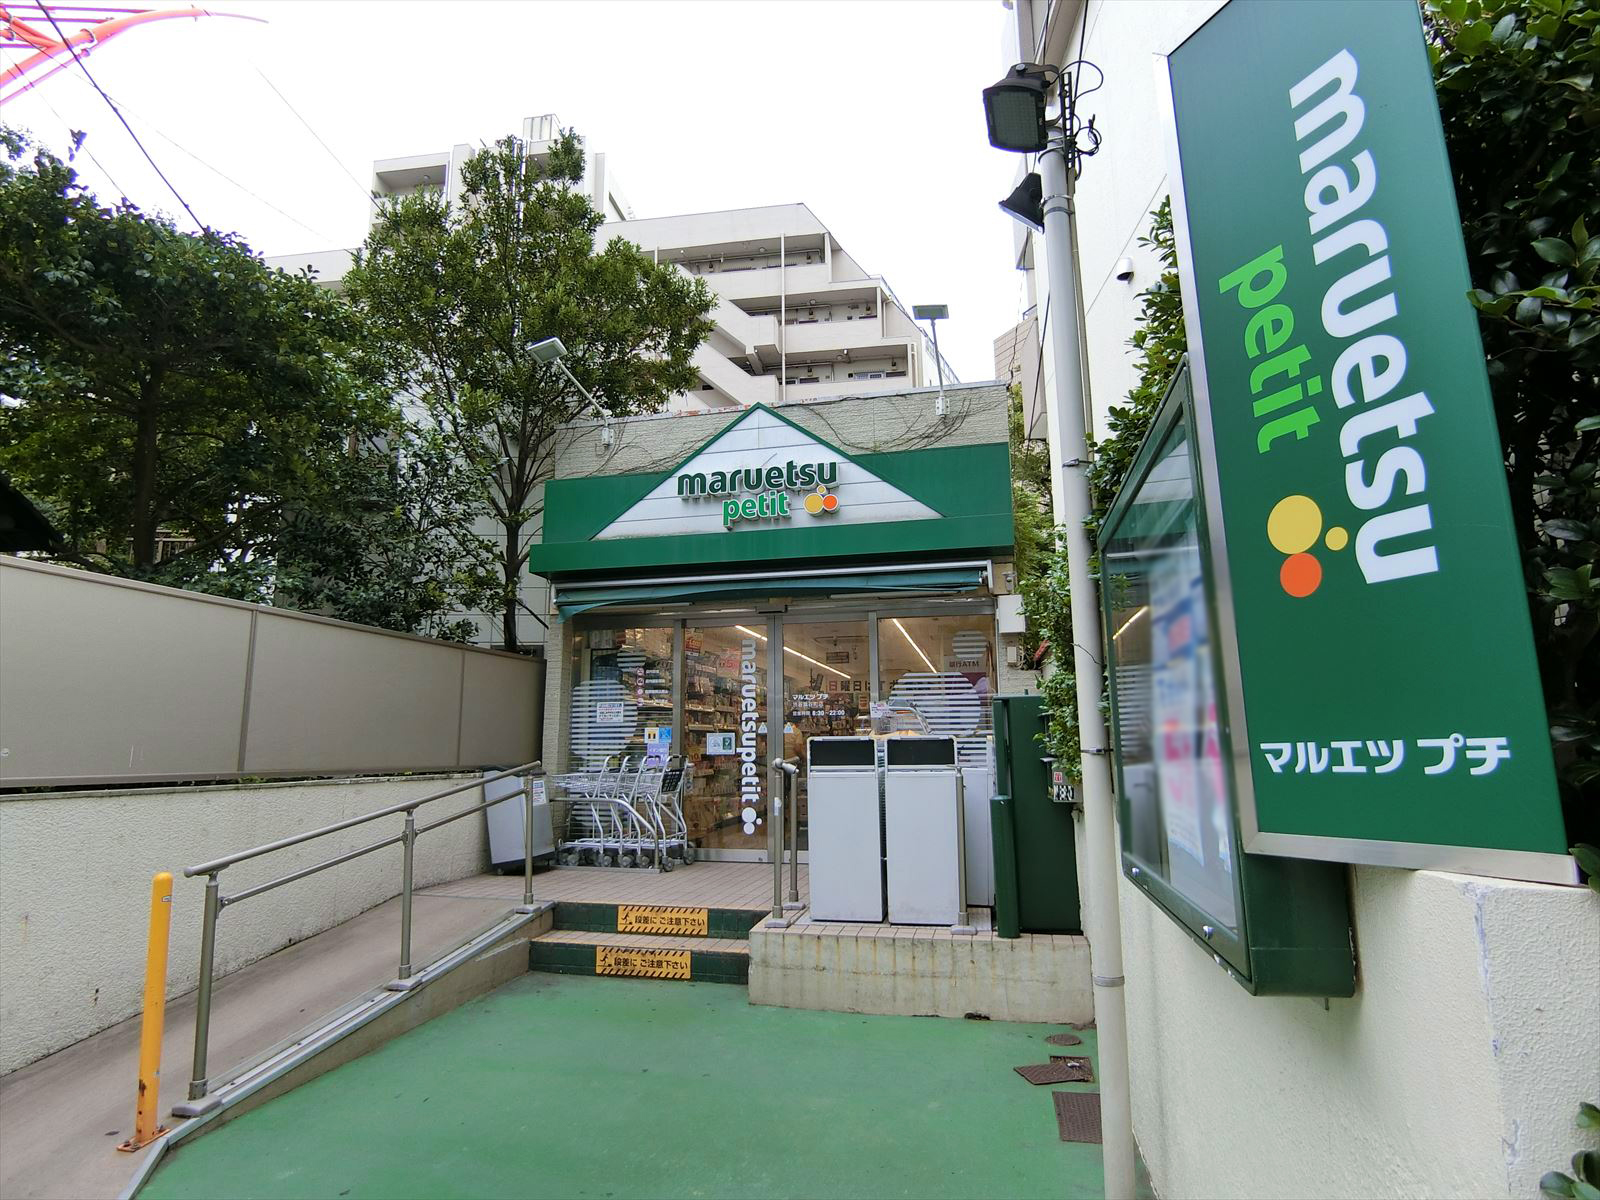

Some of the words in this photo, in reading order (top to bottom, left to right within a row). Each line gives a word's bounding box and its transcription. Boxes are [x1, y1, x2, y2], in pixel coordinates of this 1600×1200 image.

[1288, 49, 1439, 584] maruetsu
[1218, 244, 1323, 453] petit
[677, 460, 839, 497] maruetsu
[722, 490, 790, 527] petit
[1260, 739, 1404, 774] マルエツ
[1416, 732, 1511, 776] プチ
[634, 915, 657, 925] 段差に
